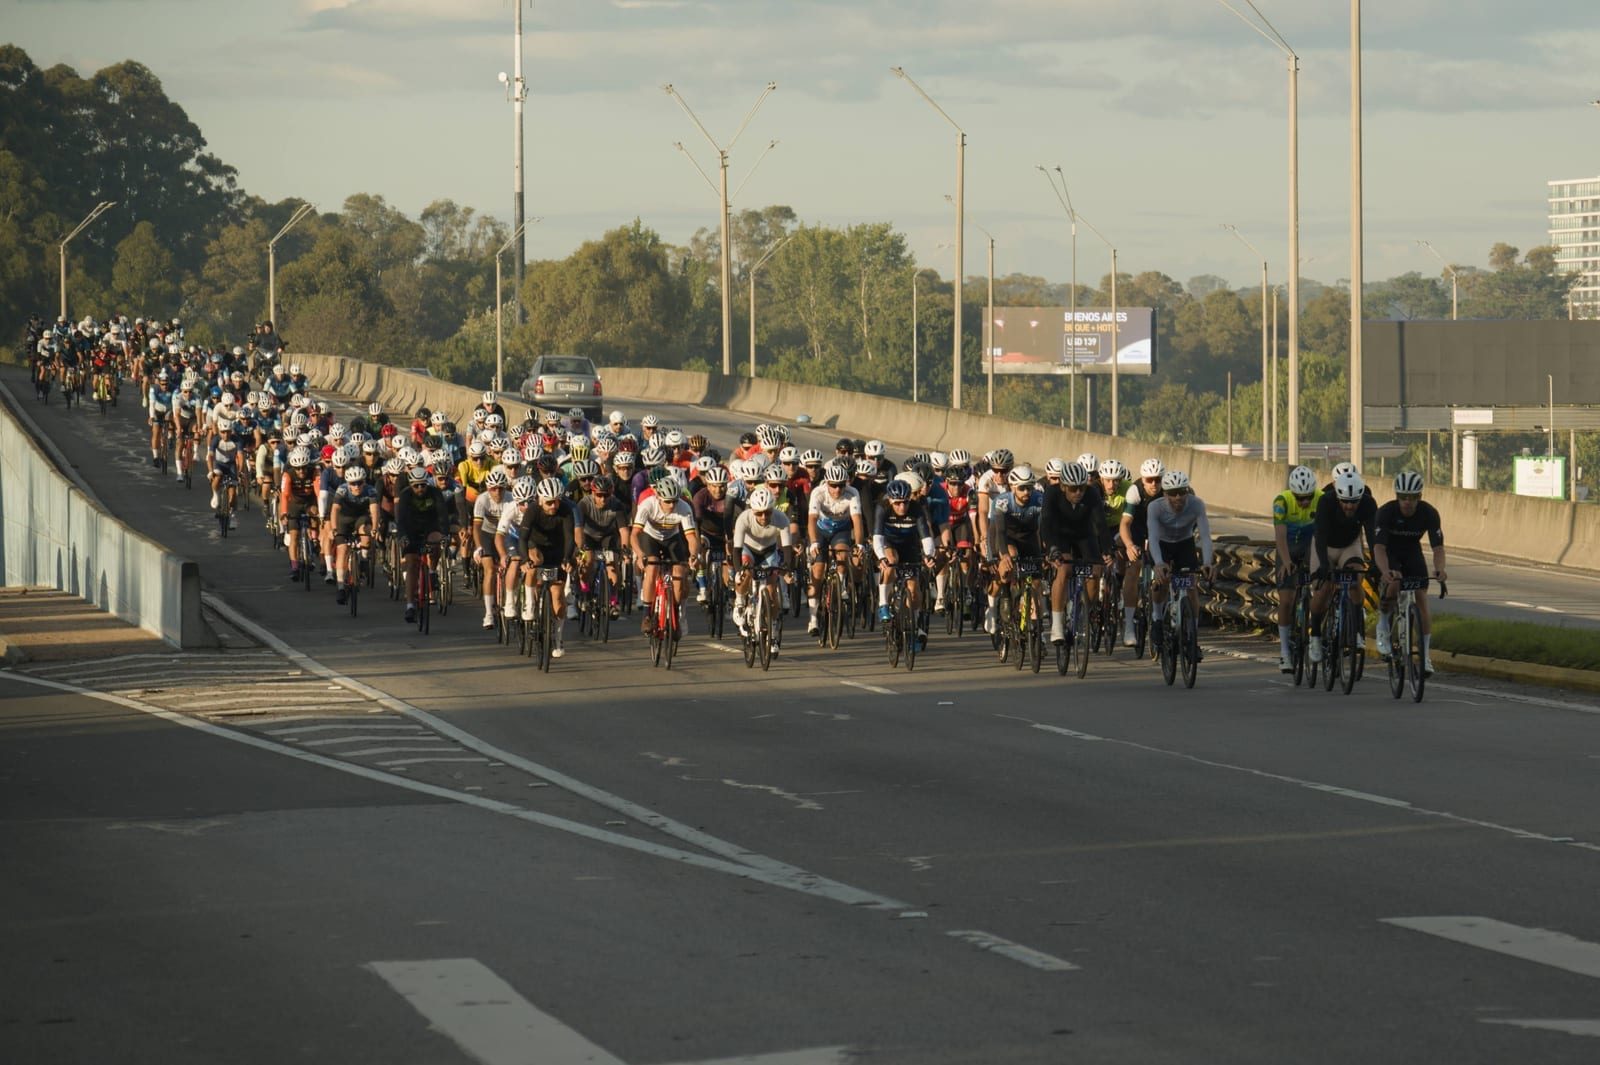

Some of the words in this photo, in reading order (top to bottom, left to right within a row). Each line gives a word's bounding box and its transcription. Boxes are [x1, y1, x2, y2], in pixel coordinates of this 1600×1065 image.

[1102, 312, 1128, 322] AIES
[1096, 323, 1121, 333] HOTL
[1174, 577, 1192, 586] 975
